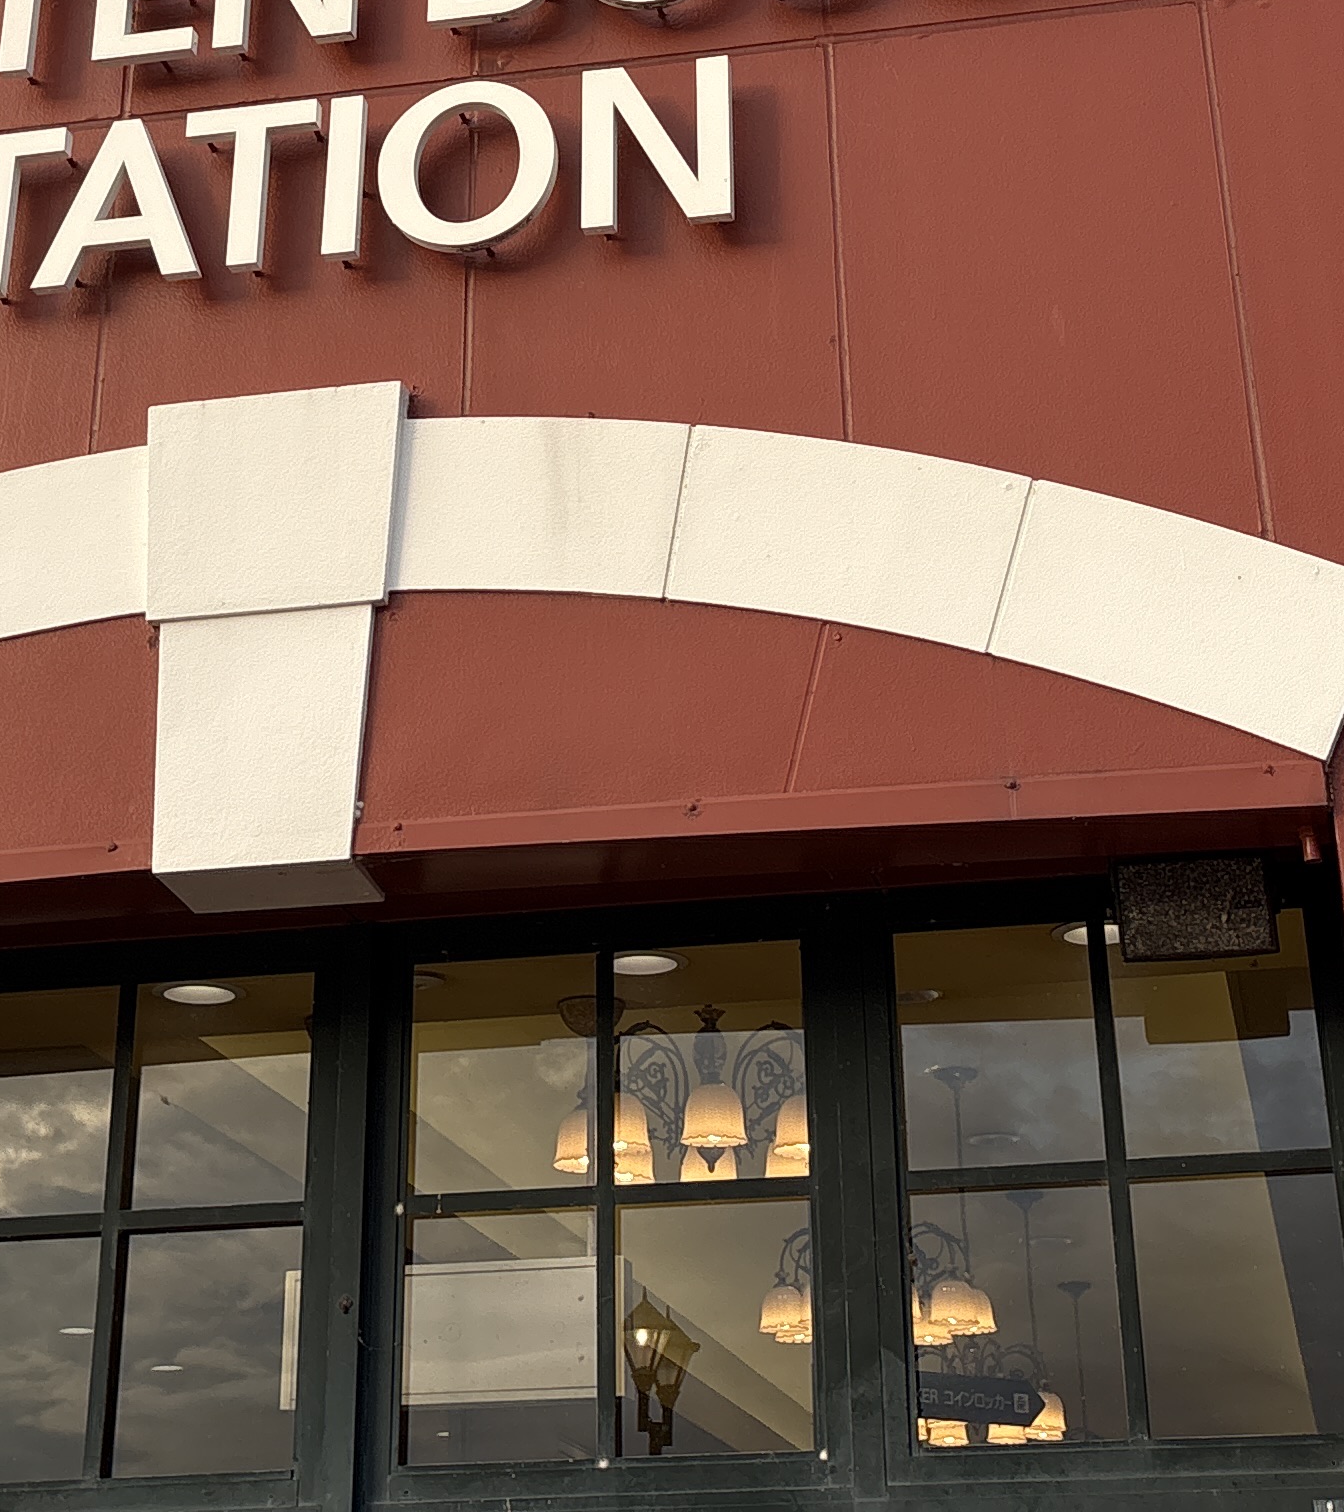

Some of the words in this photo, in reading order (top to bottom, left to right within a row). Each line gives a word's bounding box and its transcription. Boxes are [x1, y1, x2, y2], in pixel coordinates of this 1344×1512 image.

[943, 1389, 1012, 1411] コインロッカー
